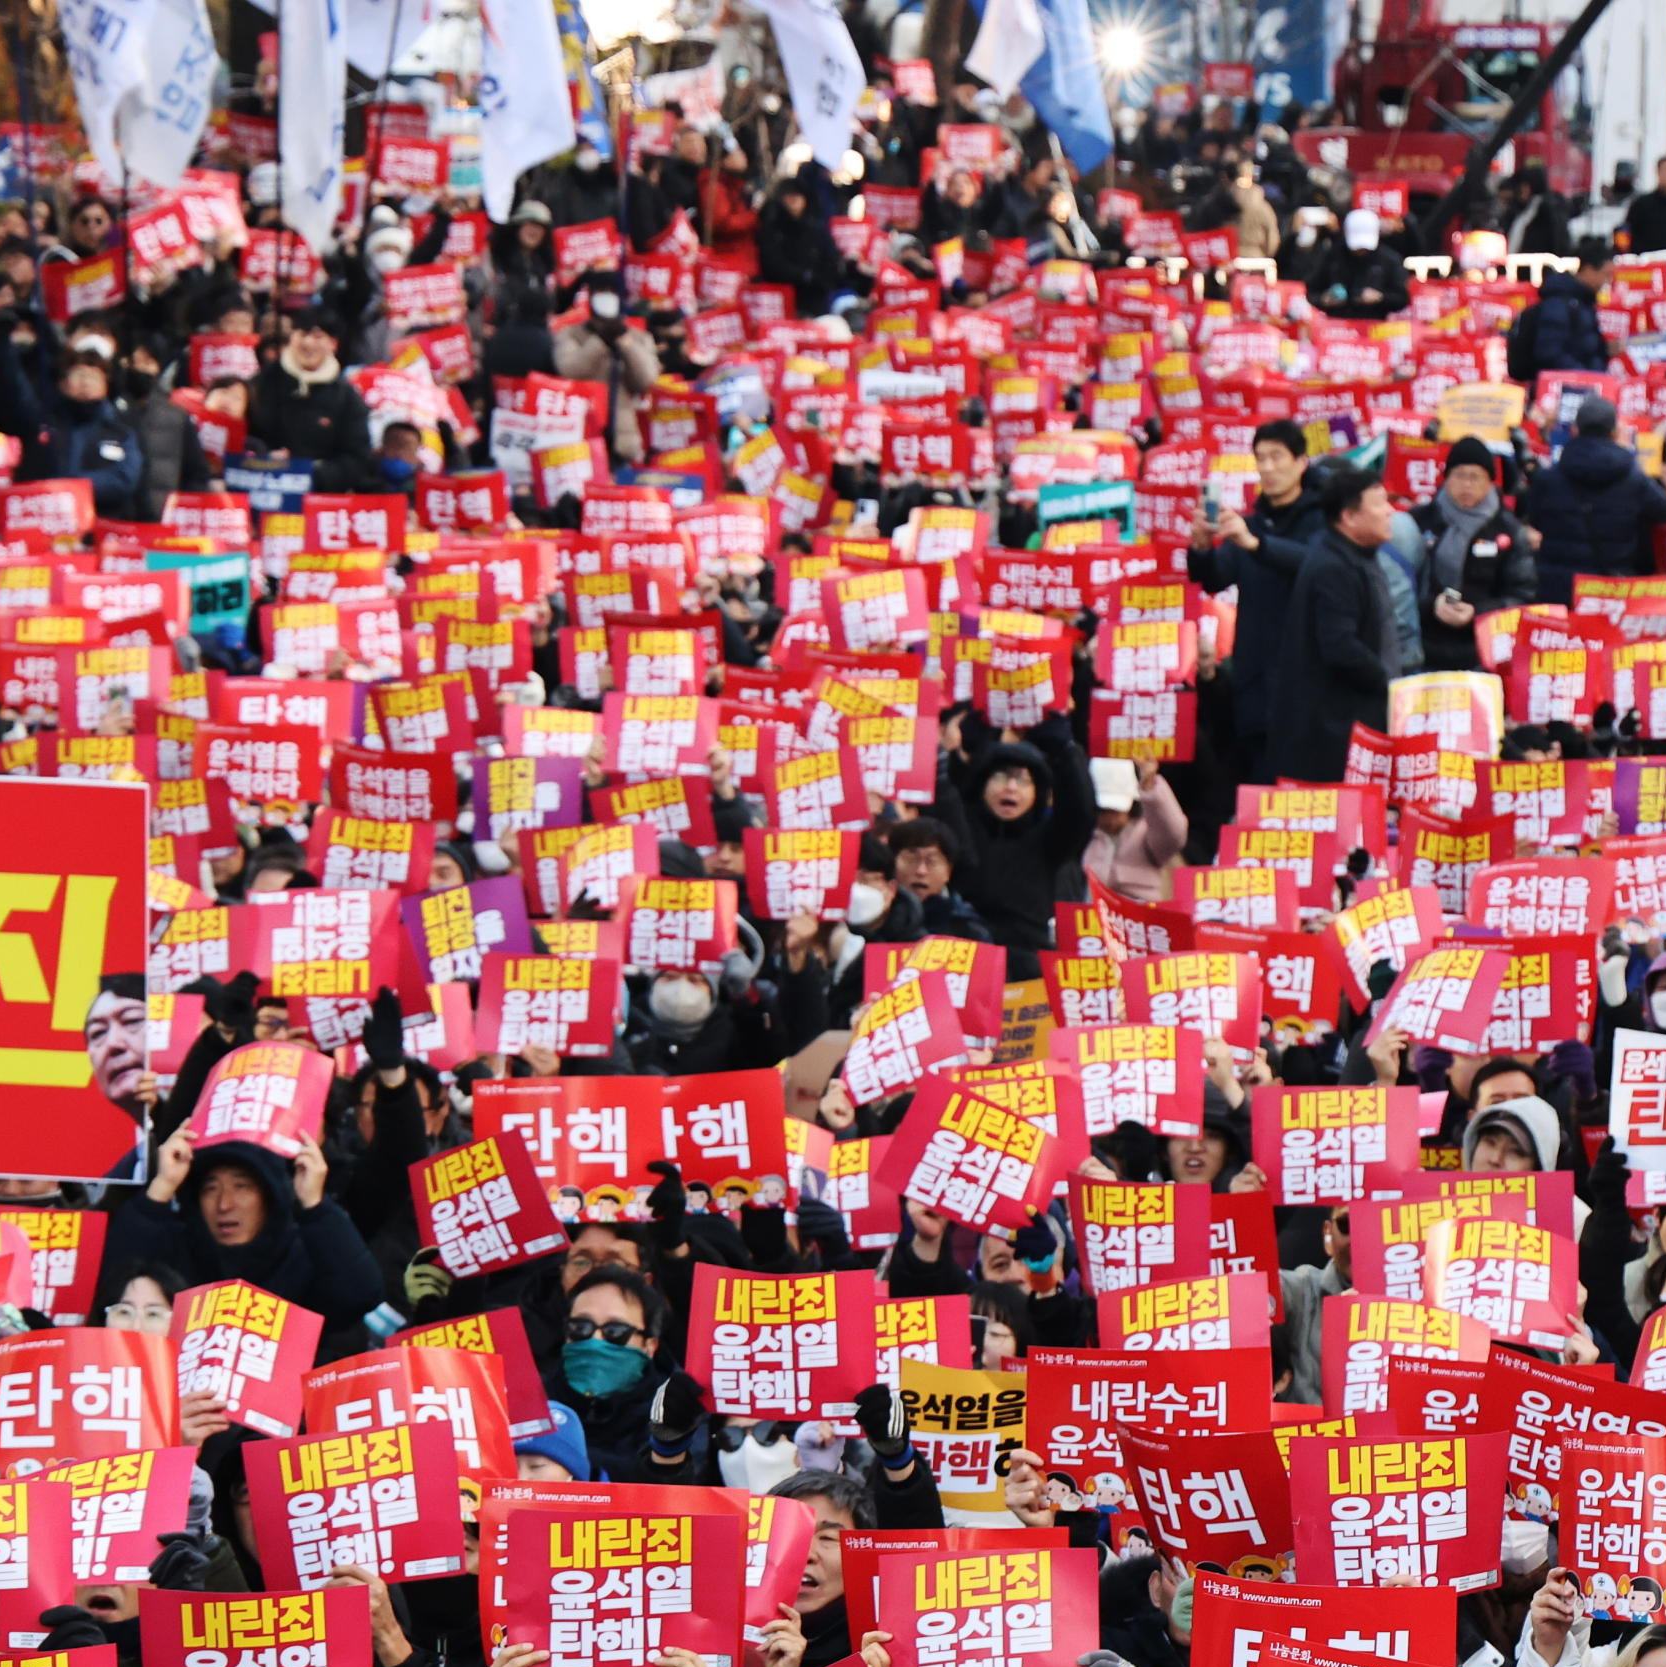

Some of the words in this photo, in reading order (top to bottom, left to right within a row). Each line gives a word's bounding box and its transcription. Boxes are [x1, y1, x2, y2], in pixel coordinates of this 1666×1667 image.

[1486, 877, 1590, 904] 윤석열을
[1483, 903, 1588, 936] 탄핵하라
[1282, 1094, 1386, 1128] 내란죄
[1281, 1126, 1385, 1167] 윤석열
[1281, 1167, 1364, 1203] 탄핵!
[714, 1276, 836, 1322] 내란죄
[711, 1323, 838, 1371] 윤석열
[711, 1370, 812, 1415] 탄핵!
[1071, 1383, 1227, 1425] 내란수괴
[550, 1516, 692, 1569] 내란죄
[549, 1564, 694, 1622] 윤석열
